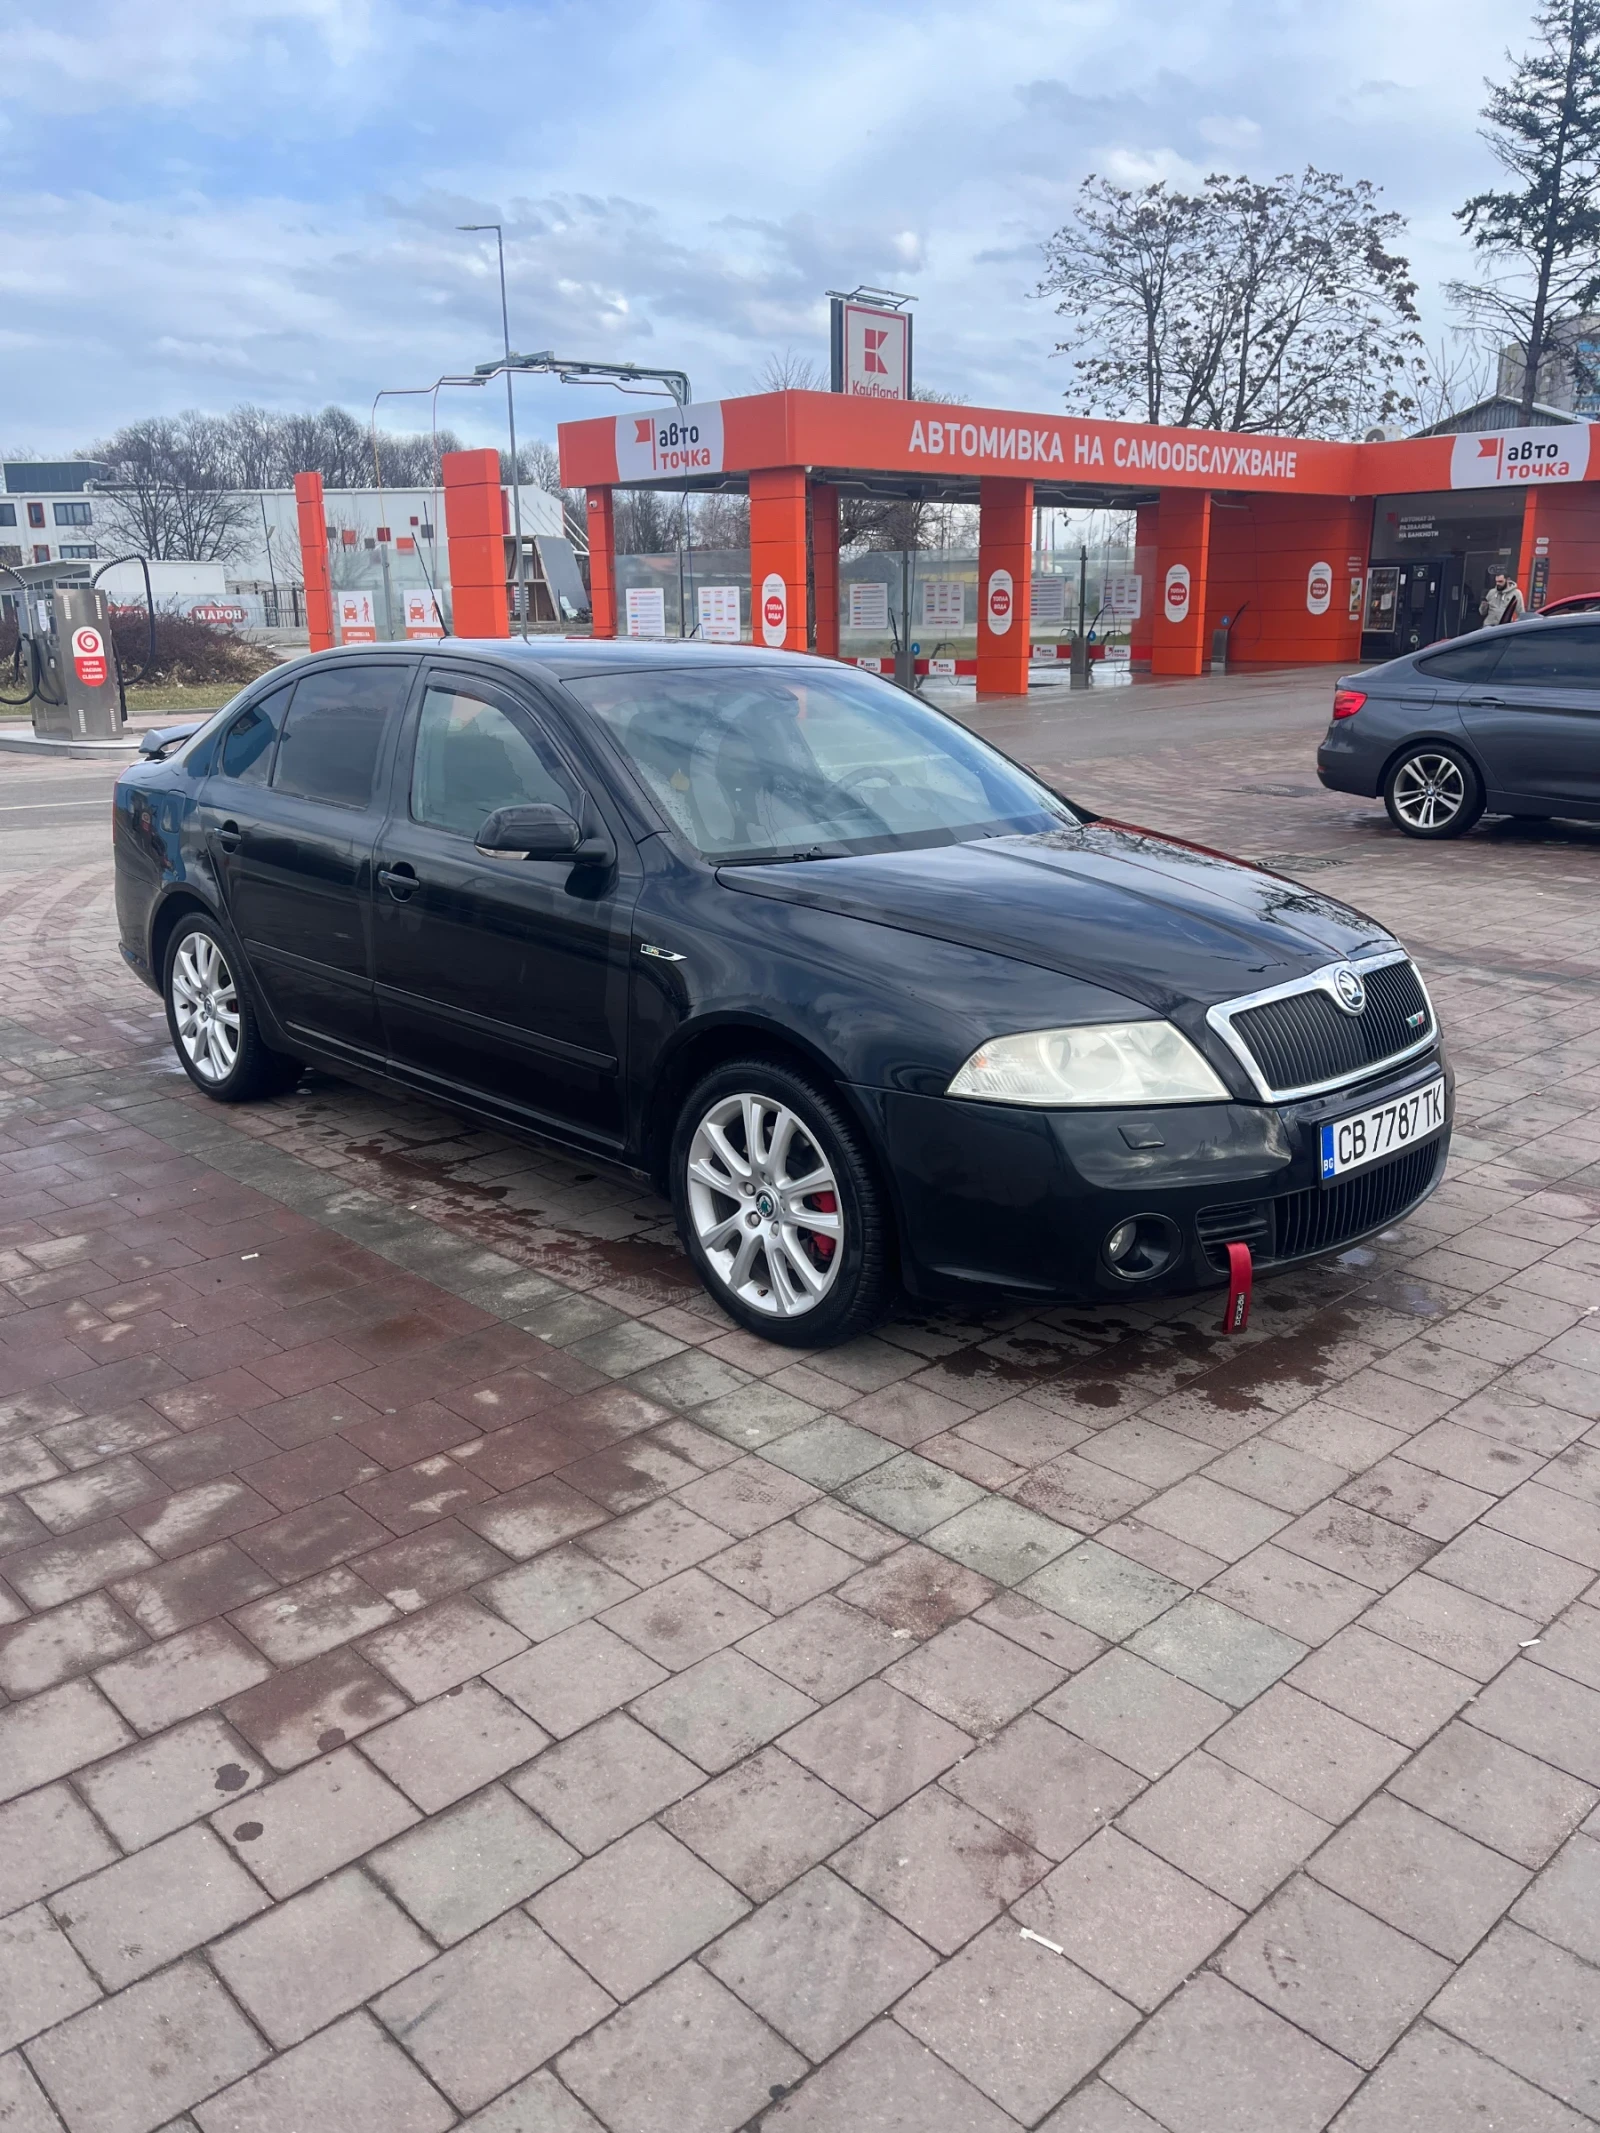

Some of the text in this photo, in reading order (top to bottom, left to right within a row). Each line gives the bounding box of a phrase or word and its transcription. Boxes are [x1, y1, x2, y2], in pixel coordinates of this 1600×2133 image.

[852, 380, 899, 399] Kaufland
[659, 422, 699, 447] авто
[660, 447, 711, 470] точка
[908, 419, 1297, 478] АВТОМИВКА НА САМООБСЛУЖВАНЕ
[1507, 441, 1559, 461] авто
[1507, 461, 1570, 479] точка
[195, 609, 243, 620] МАРОН
[1371, 1096, 1420, 1153] 7787
[1323, 1157, 1334, 1172] BG
